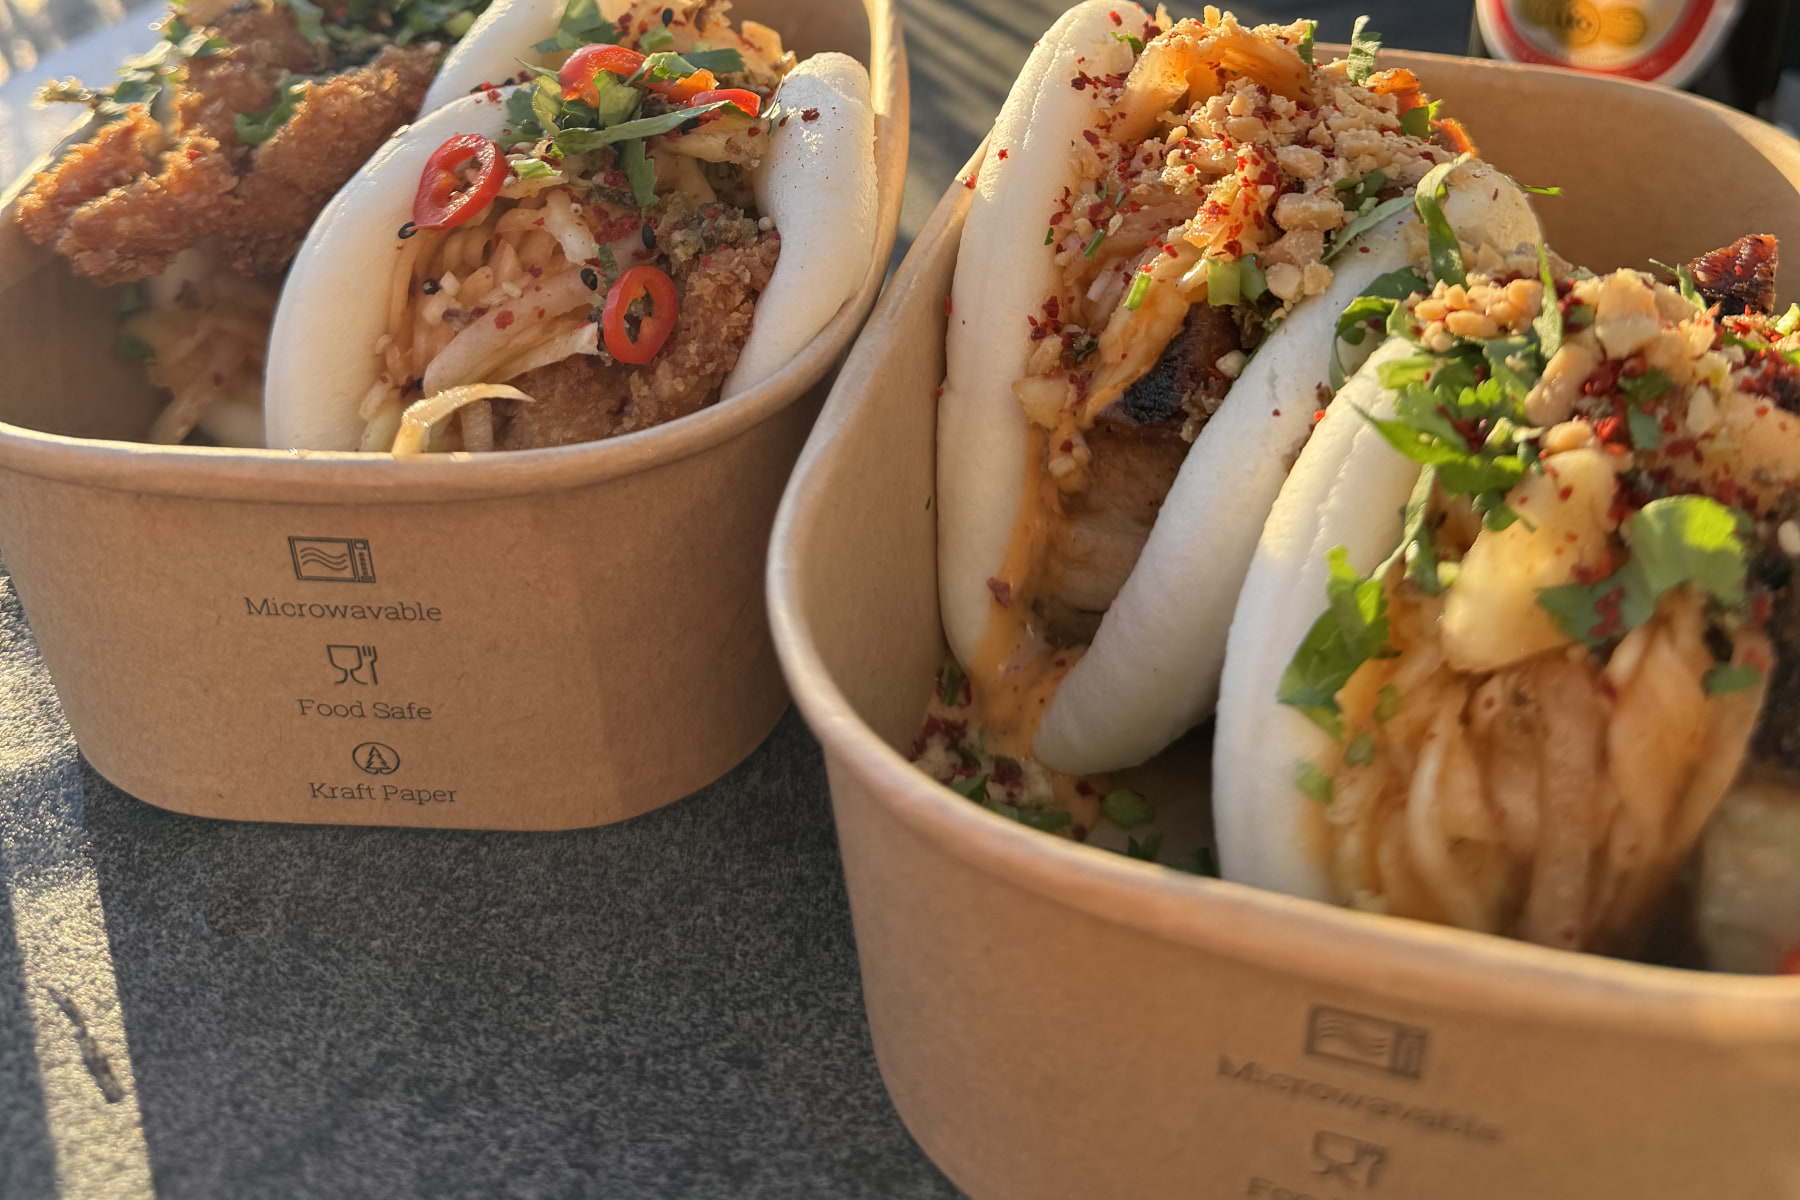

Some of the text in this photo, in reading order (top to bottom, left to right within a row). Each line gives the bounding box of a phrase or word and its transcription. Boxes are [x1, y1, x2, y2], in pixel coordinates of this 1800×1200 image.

[244, 596, 442, 621] Microwavable
[297, 698, 433, 720] Food Safe
[309, 782, 457, 805] Kraft Paper
